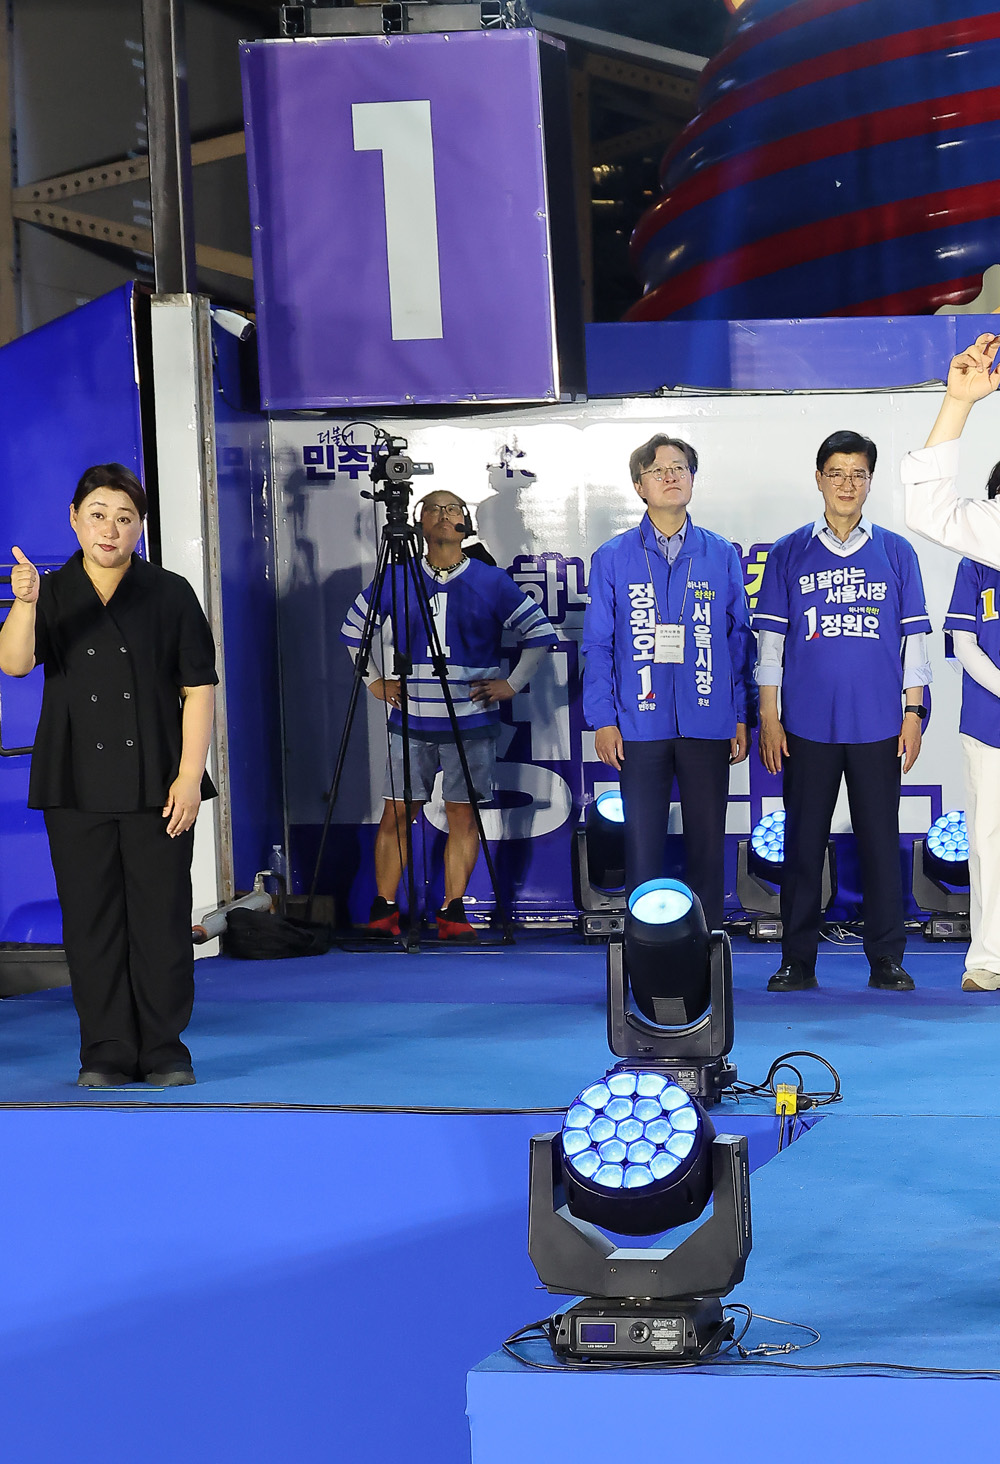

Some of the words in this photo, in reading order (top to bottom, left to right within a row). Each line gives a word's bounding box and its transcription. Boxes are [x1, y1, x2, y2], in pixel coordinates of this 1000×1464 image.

[351, 100, 443, 341] 1
[317, 427, 354, 446] 더불어
[303, 445, 388, 480] 민주
[686, 581, 709, 589] 하나씩
[694, 590, 715, 600] 착착!
[799, 574, 816, 595] 일
[816, 567, 866, 590] 잘하는
[825, 582, 887, 604] 서울시장
[628, 582, 656, 661] 정원오
[981, 588, 999, 622] 1
[427, 592, 450, 658] 1
[804, 606, 819, 641] 1
[820, 613, 880, 639] 정원오
[692, 602, 713, 695] 서울시장
[637, 665, 656, 700] 1
[697, 698, 710, 707] 후보
